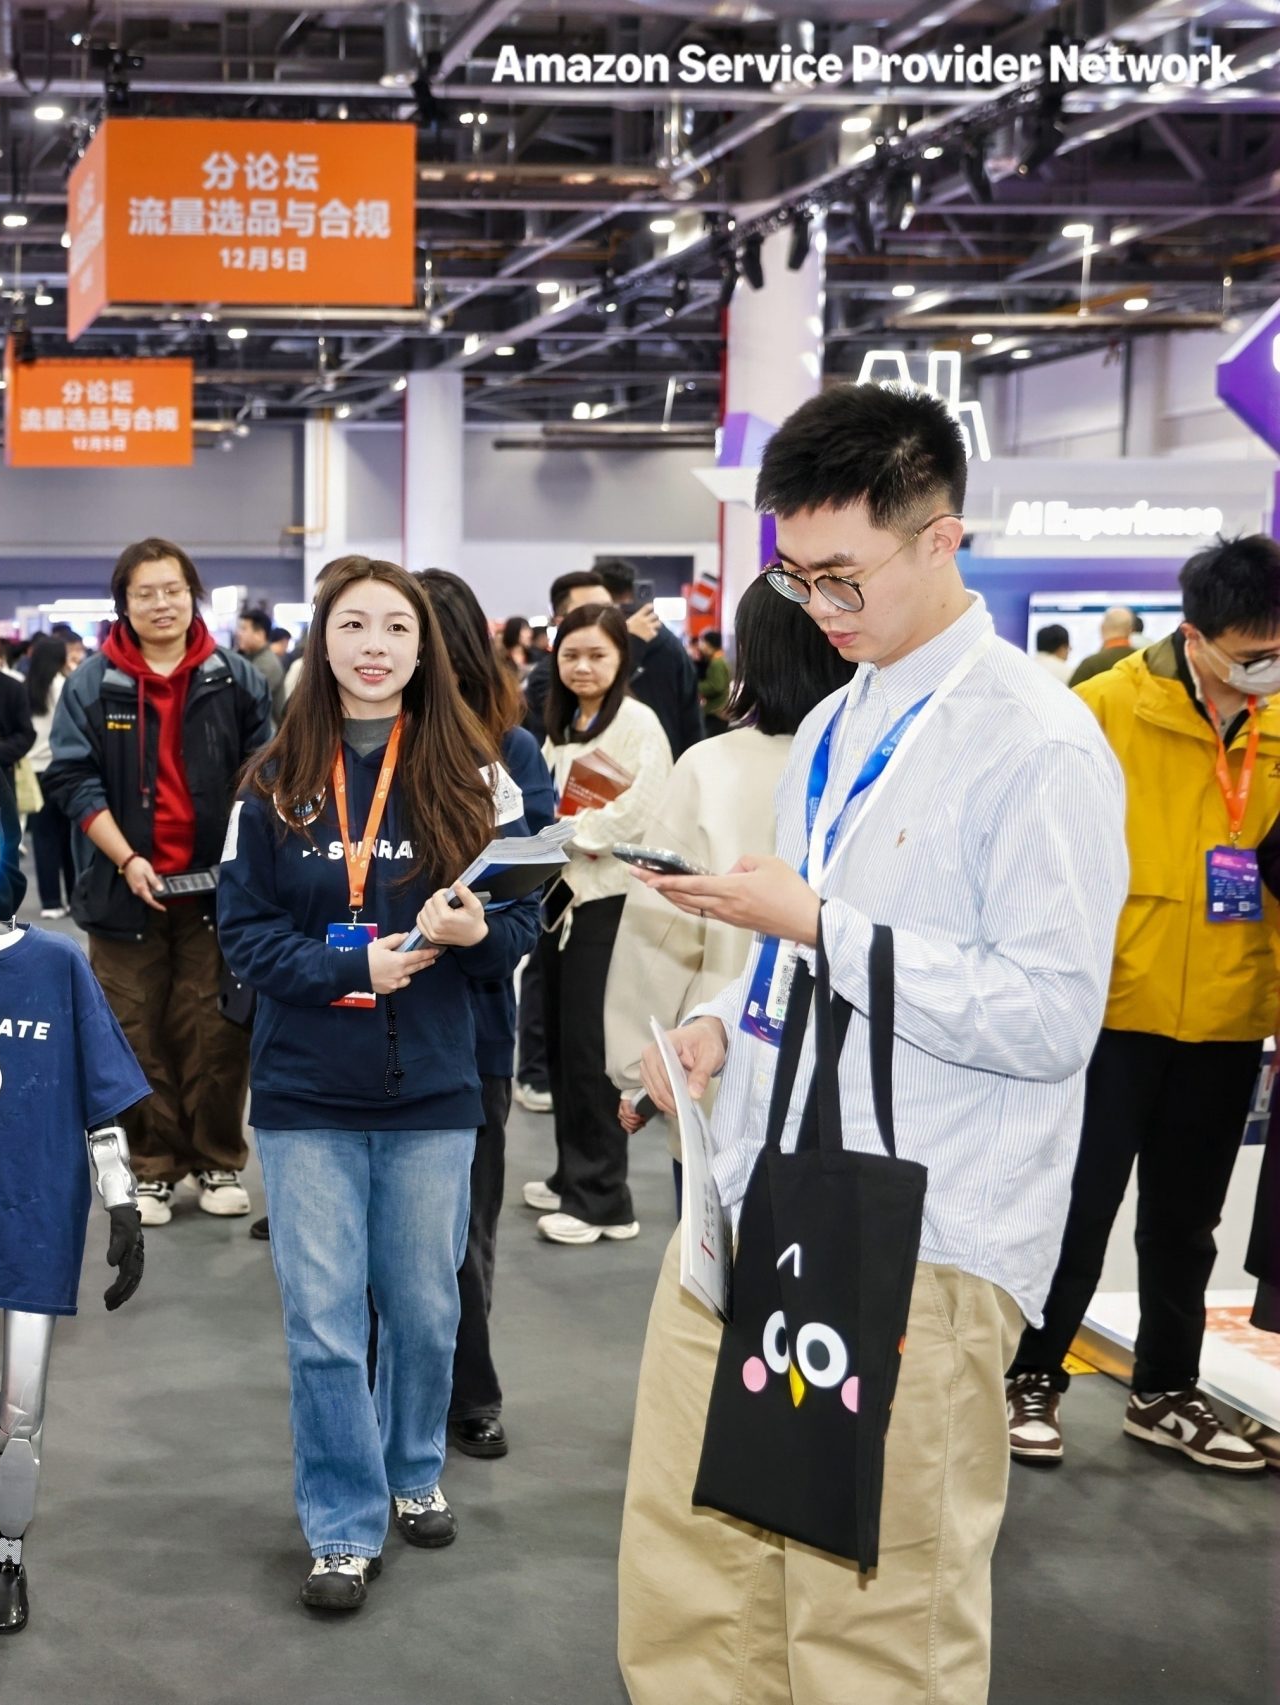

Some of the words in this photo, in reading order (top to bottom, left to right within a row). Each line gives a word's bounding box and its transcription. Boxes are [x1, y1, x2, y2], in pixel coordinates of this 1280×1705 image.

[202, 151, 320, 192] 分论坛
[128, 197, 392, 240] 流量选品与合规
[220, 247, 308, 273] 12月5日
[61, 379, 135, 405] 分论坛
[20, 406, 180, 432] 流量选品与合规
[1006, 500, 1043, 537] AI
[1045, 500, 1223, 542] Experience
